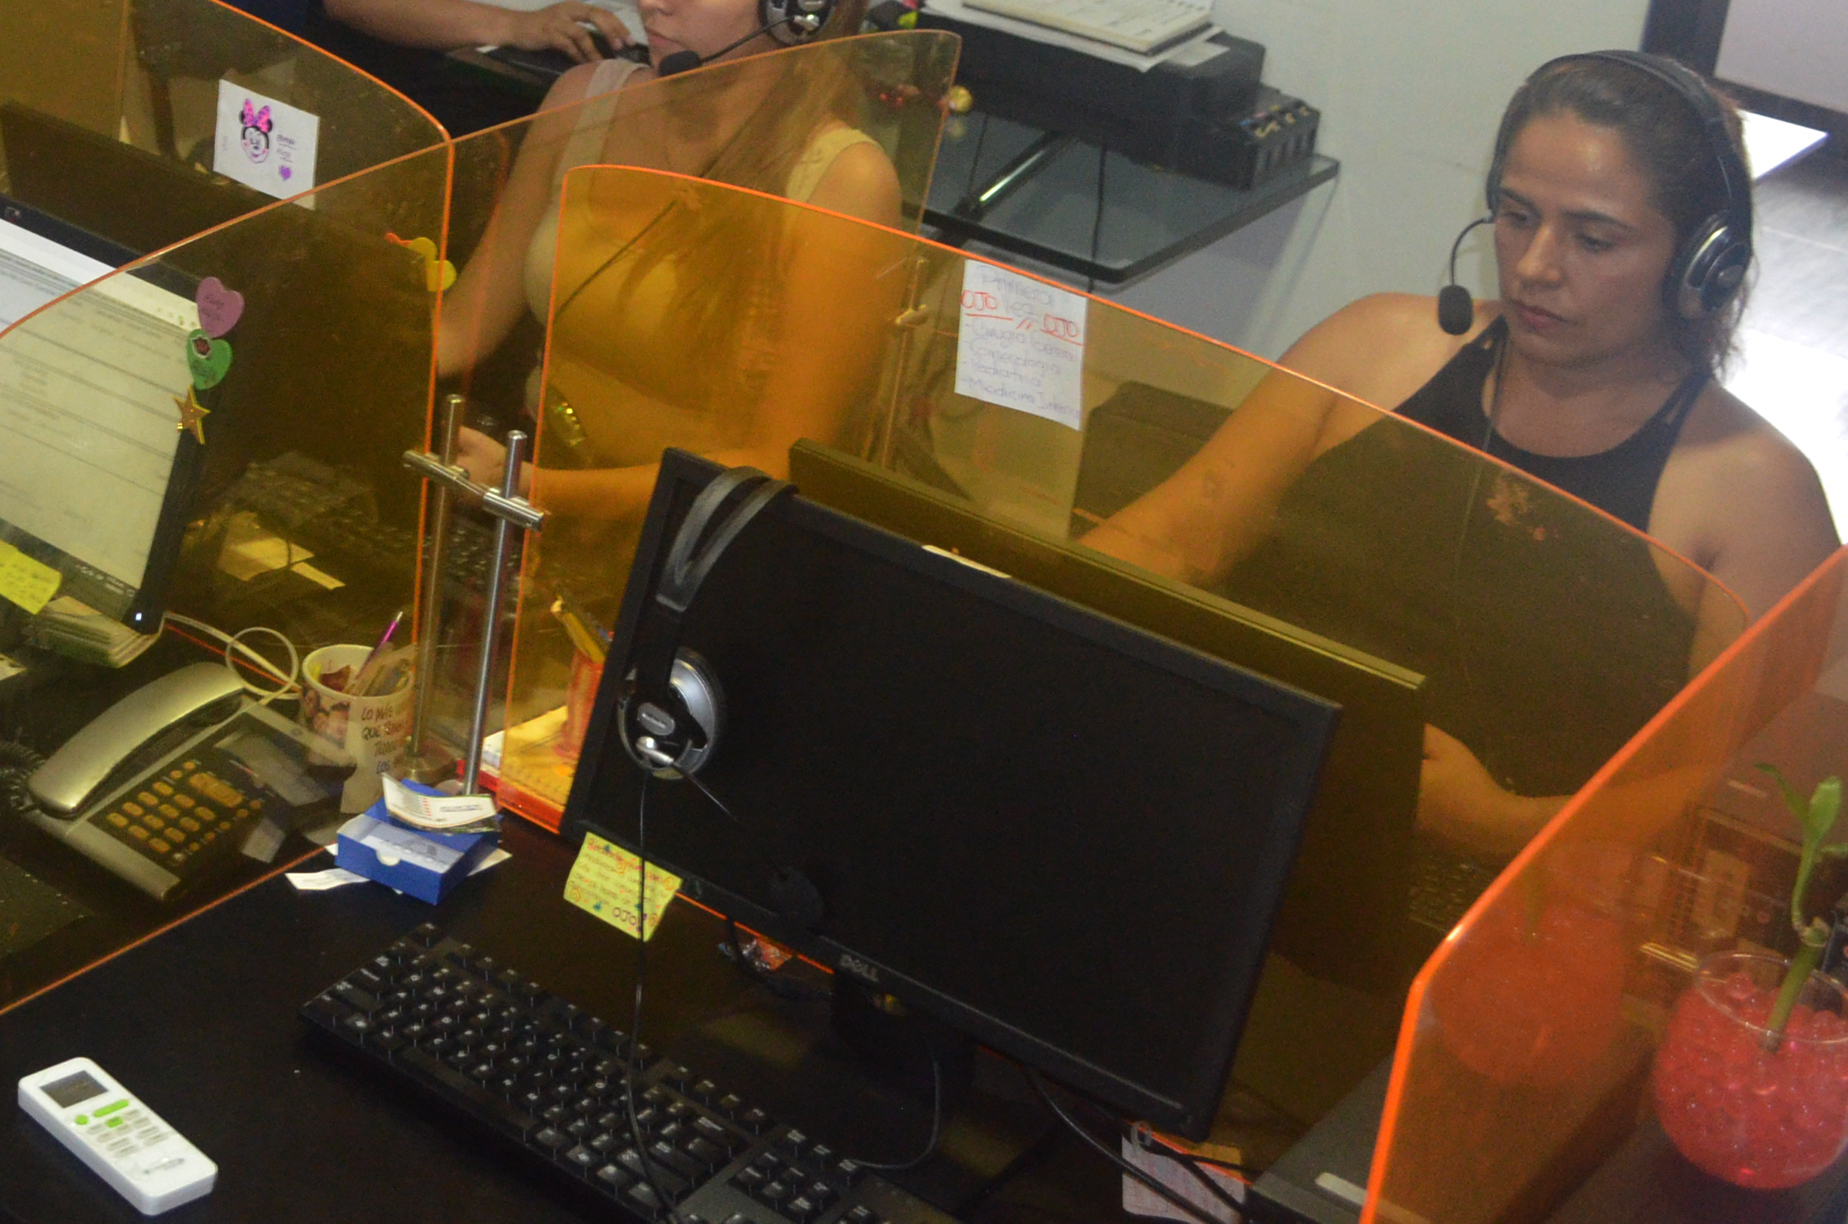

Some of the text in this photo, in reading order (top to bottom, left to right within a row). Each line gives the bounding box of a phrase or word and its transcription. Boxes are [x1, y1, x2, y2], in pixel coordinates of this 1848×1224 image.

[961, 289, 998, 311] OJO
[1043, 313, 1079, 337] OJO
[840, 954, 879, 982] DELL
